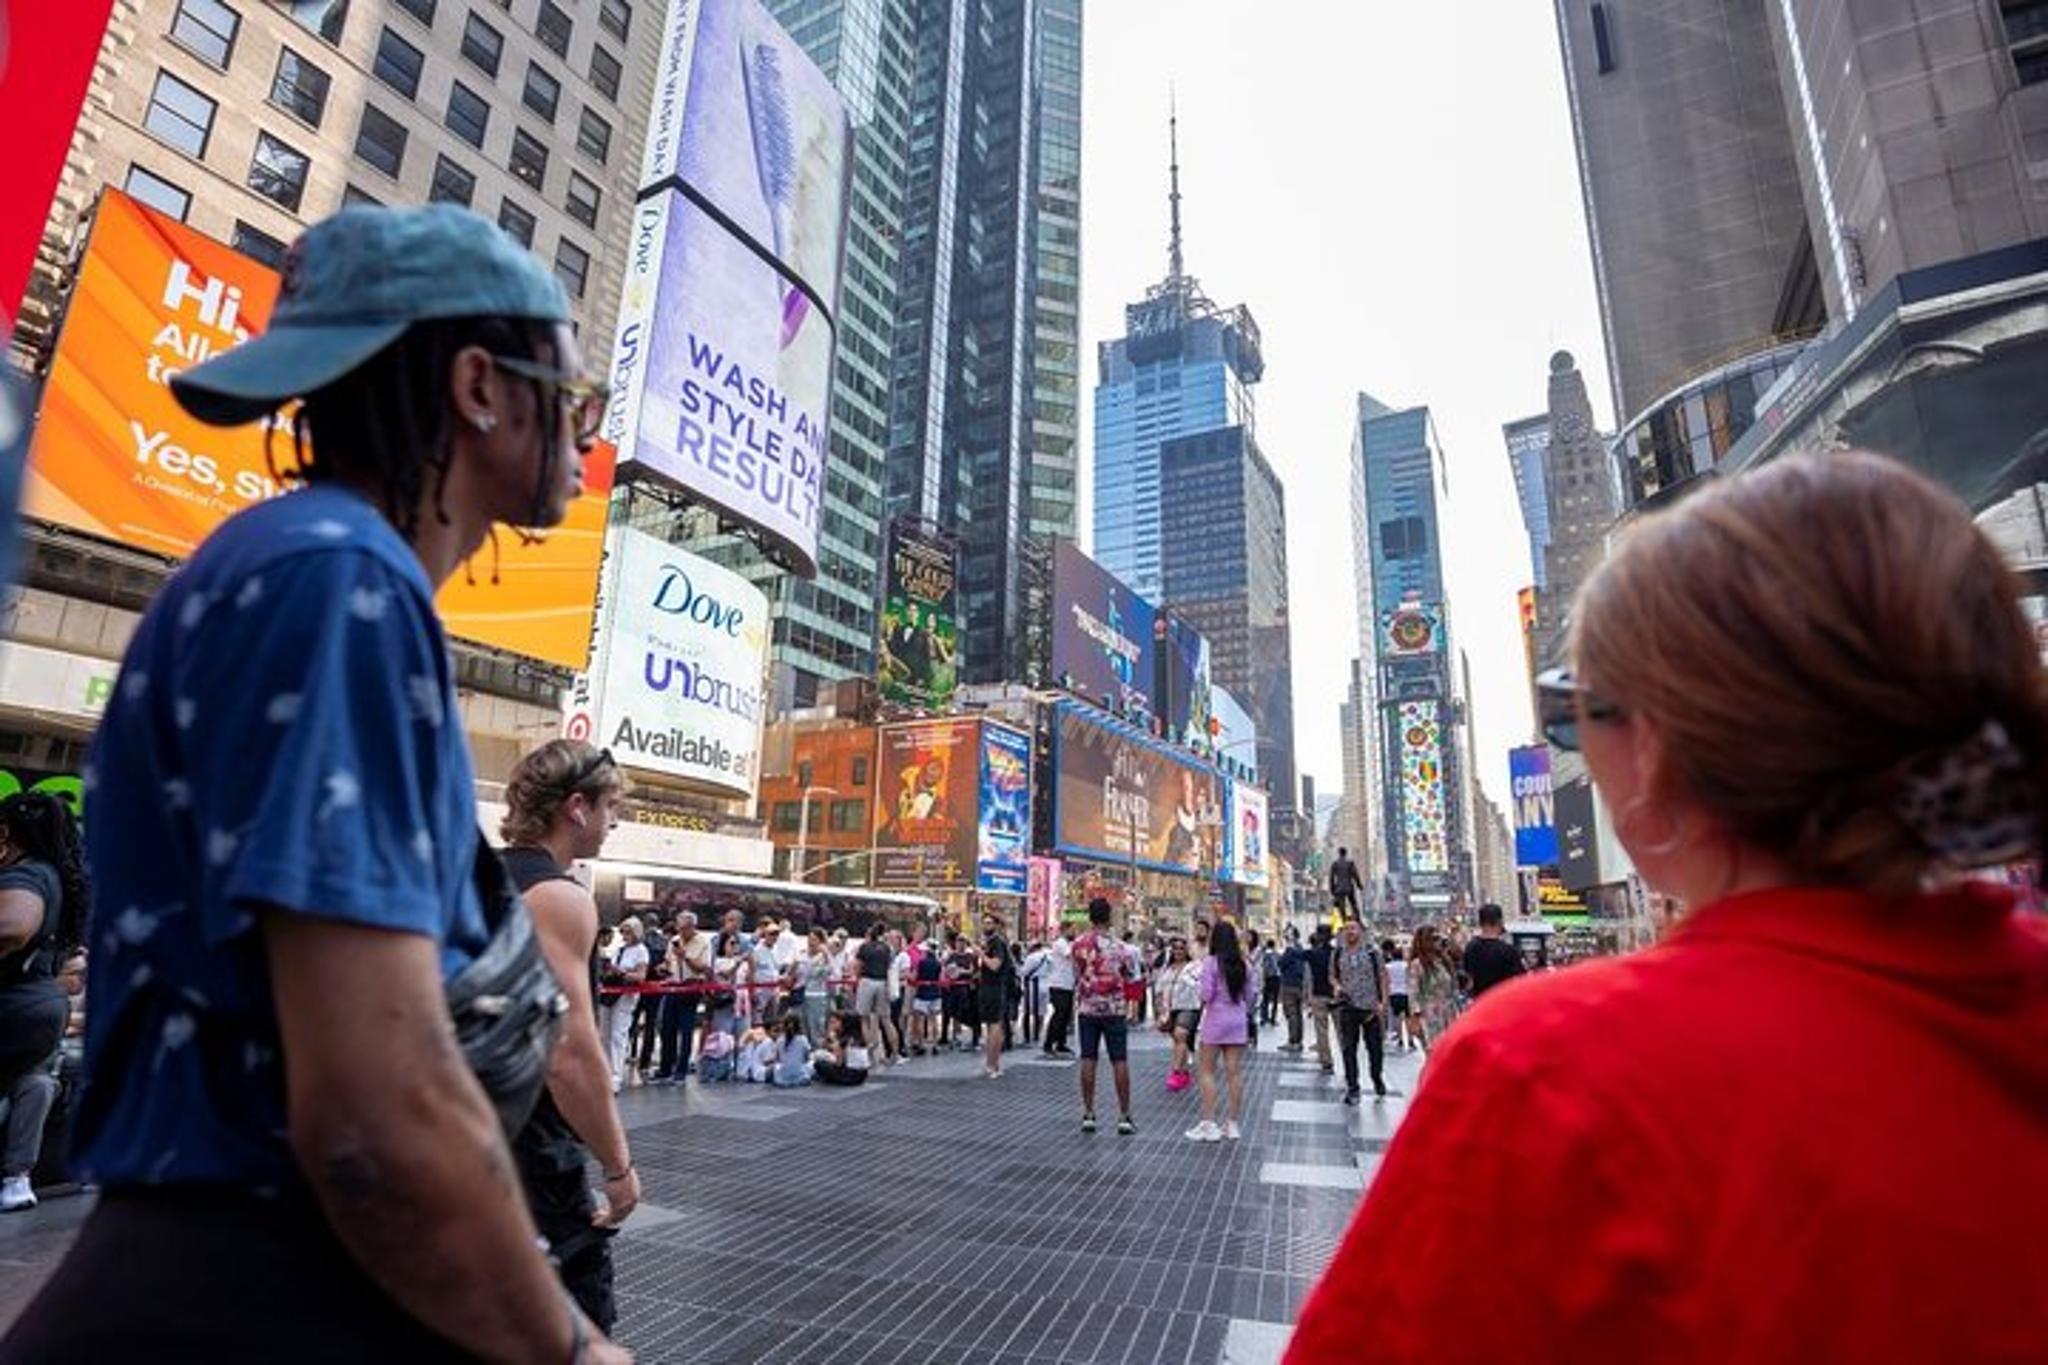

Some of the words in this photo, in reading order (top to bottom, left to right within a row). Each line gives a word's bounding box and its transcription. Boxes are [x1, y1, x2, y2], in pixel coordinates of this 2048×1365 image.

[634, 208, 660, 274] Dove
[688, 332, 787, 424] WASH
[130, 419, 226, 494] Yes,
[680, 378, 784, 464] STYLE
[652, 562, 744, 638] Dove
[611, 715, 732, 772] Available
